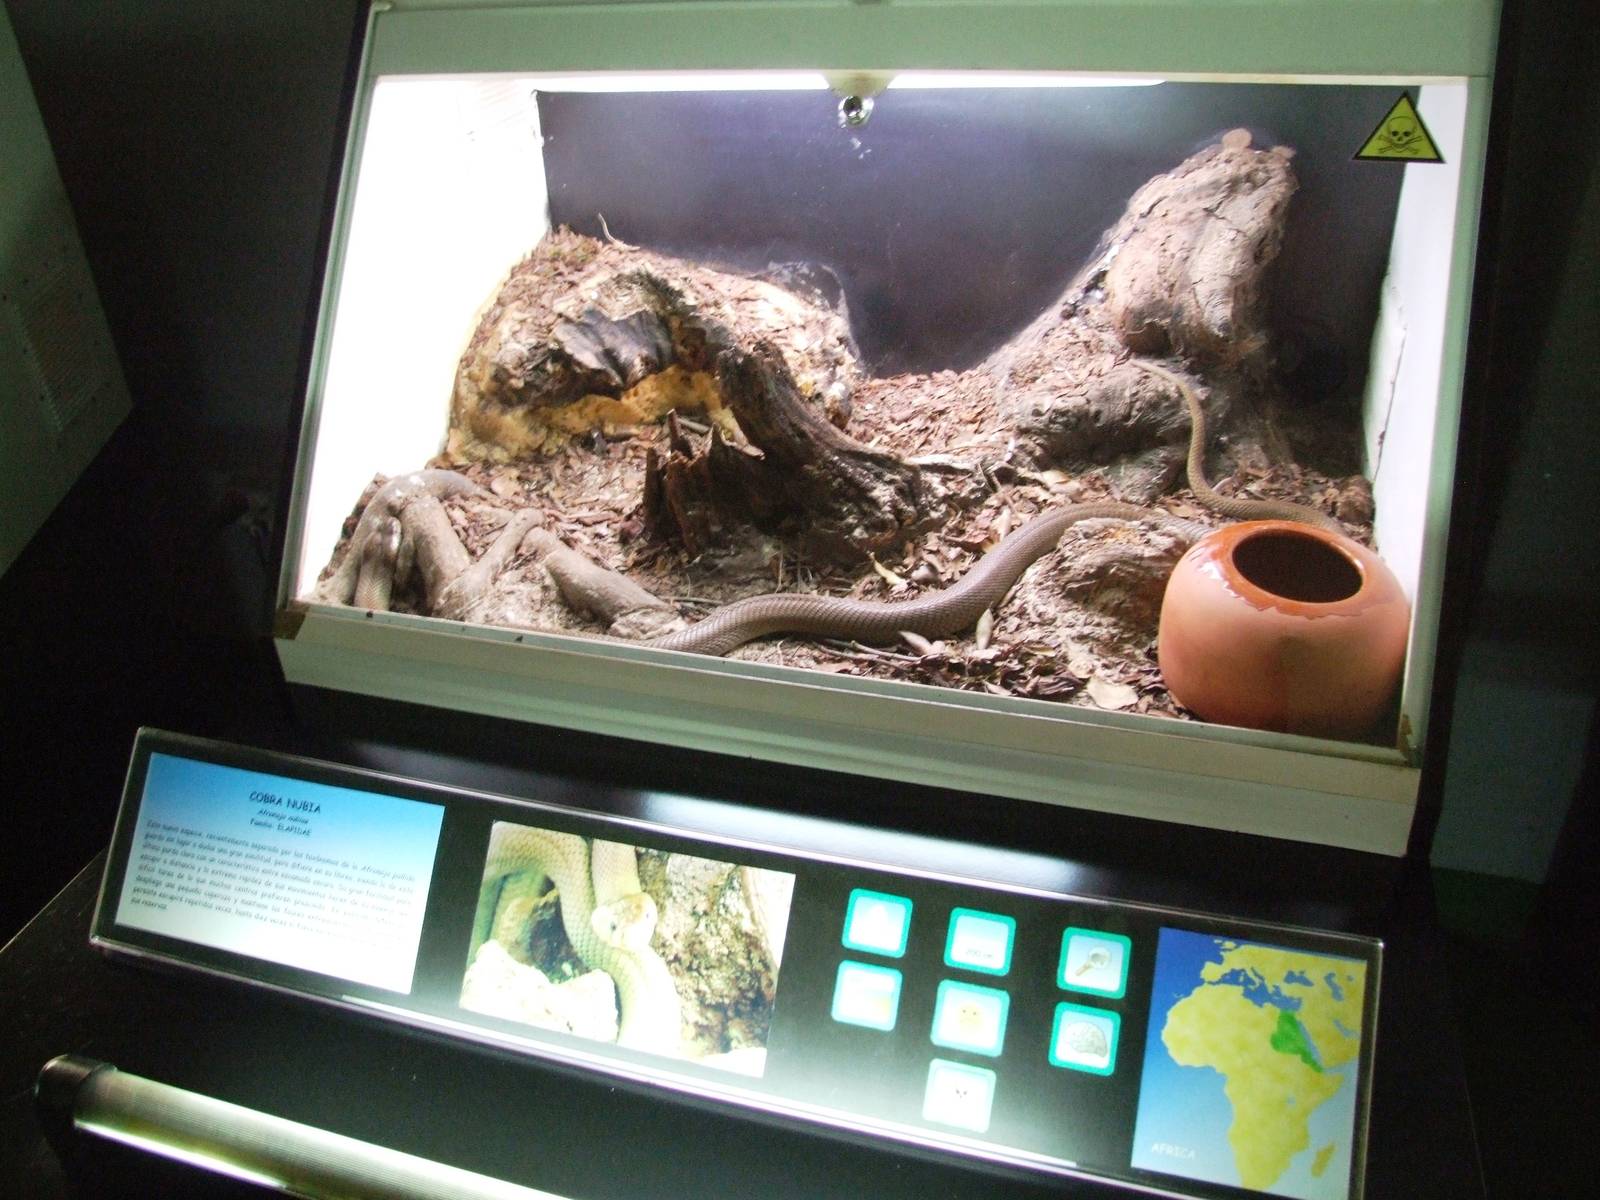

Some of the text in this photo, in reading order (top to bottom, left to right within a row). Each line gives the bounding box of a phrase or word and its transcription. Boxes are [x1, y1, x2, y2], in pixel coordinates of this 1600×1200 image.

[249, 791, 321, 813] COBRA NUBIA
[1151, 1143, 1196, 1160] AFRICA
